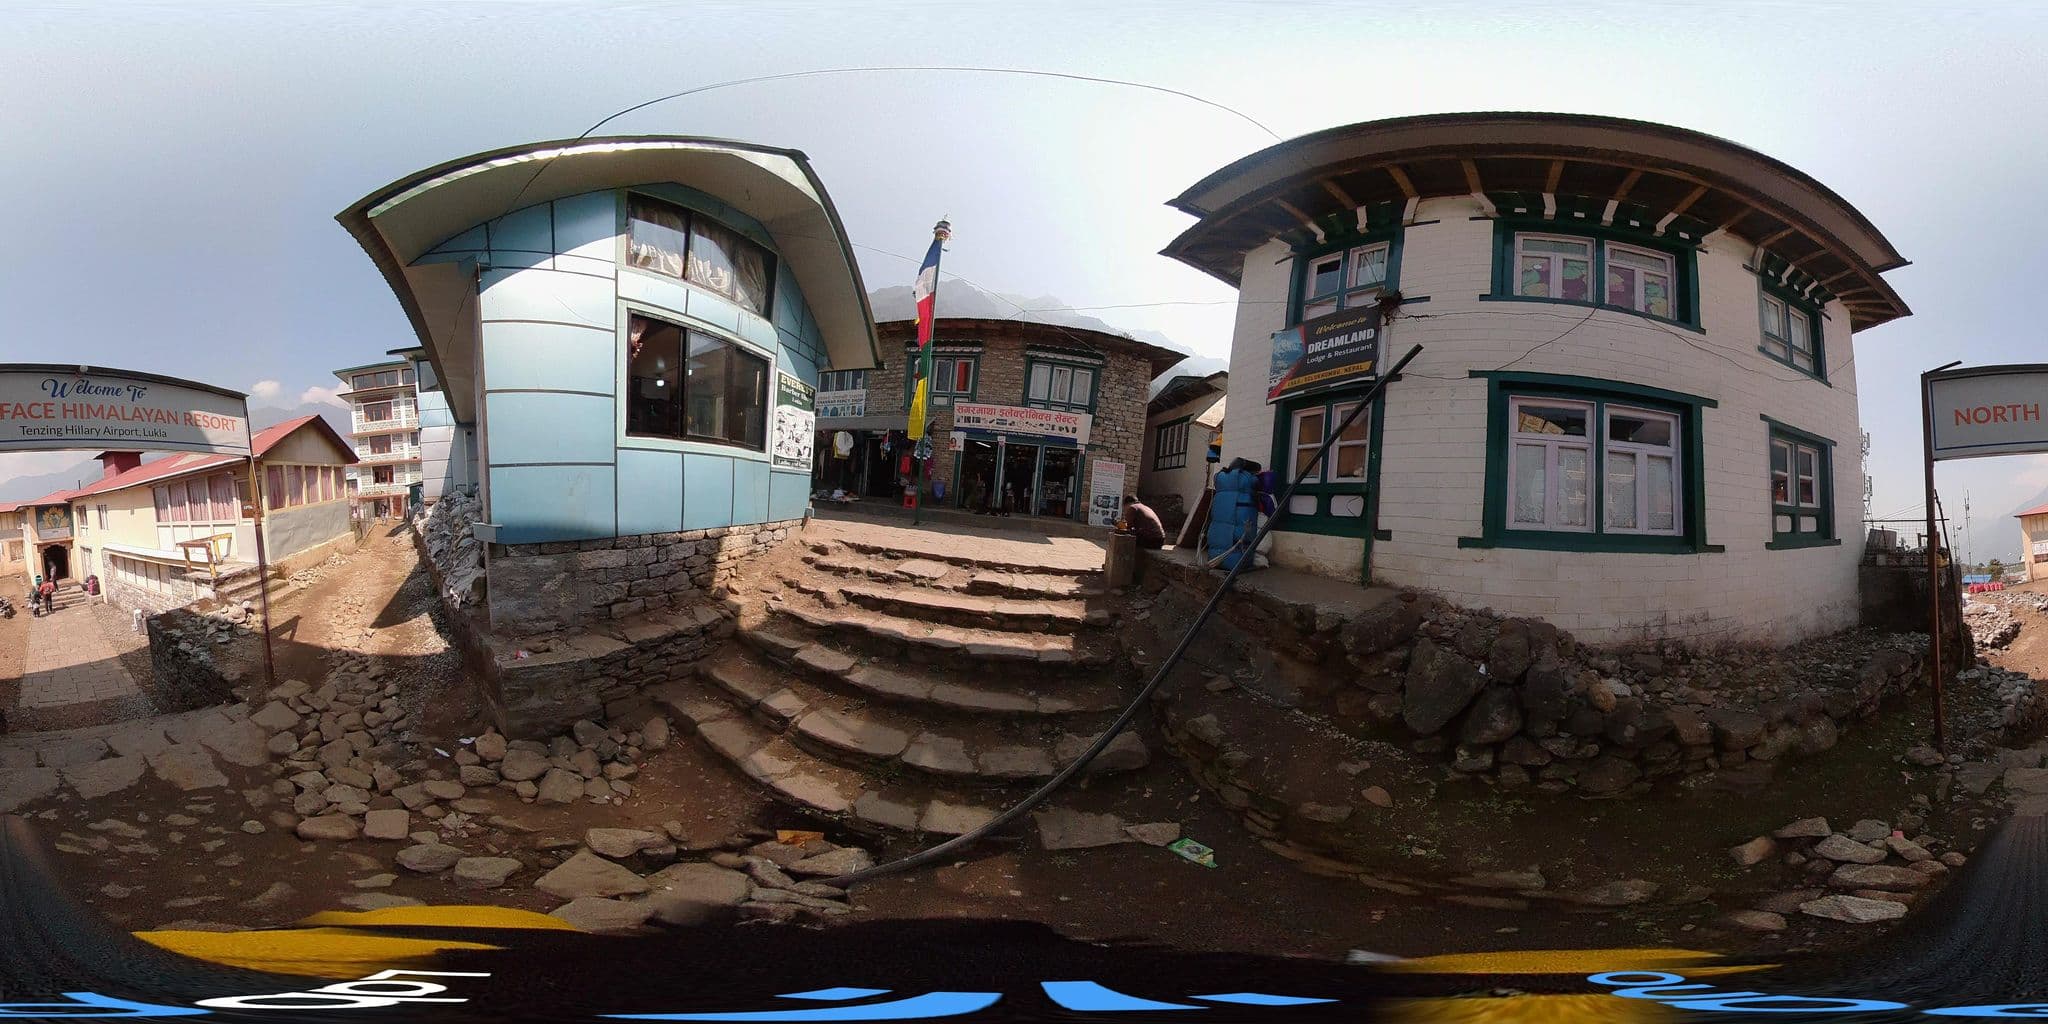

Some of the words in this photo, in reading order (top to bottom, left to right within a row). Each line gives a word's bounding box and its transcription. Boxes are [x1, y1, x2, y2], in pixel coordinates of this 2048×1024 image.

[1307, 328, 1375, 354] DREAMLAND
[1306, 355, 1325, 364] Lodge
[1334, 343, 1373, 357] Restaurant
[41, 377, 124, 399] Welcome
[127, 384, 147, 402] To
[780, 374, 814, 397] EVEREST
[0, 401, 56, 420] FACE
[61, 402, 180, 425] HIMALAYAN
[183, 411, 237, 432] RESORT
[956, 405, 996, 416] सगरमाथा
[1954, 403, 2040, 426] NORTH
[19, 425, 63, 438] Tenzing
[65, 424, 100, 438] Hillary
[103, 426, 141, 438] Airport,
[143, 427, 167, 438] Lukla
